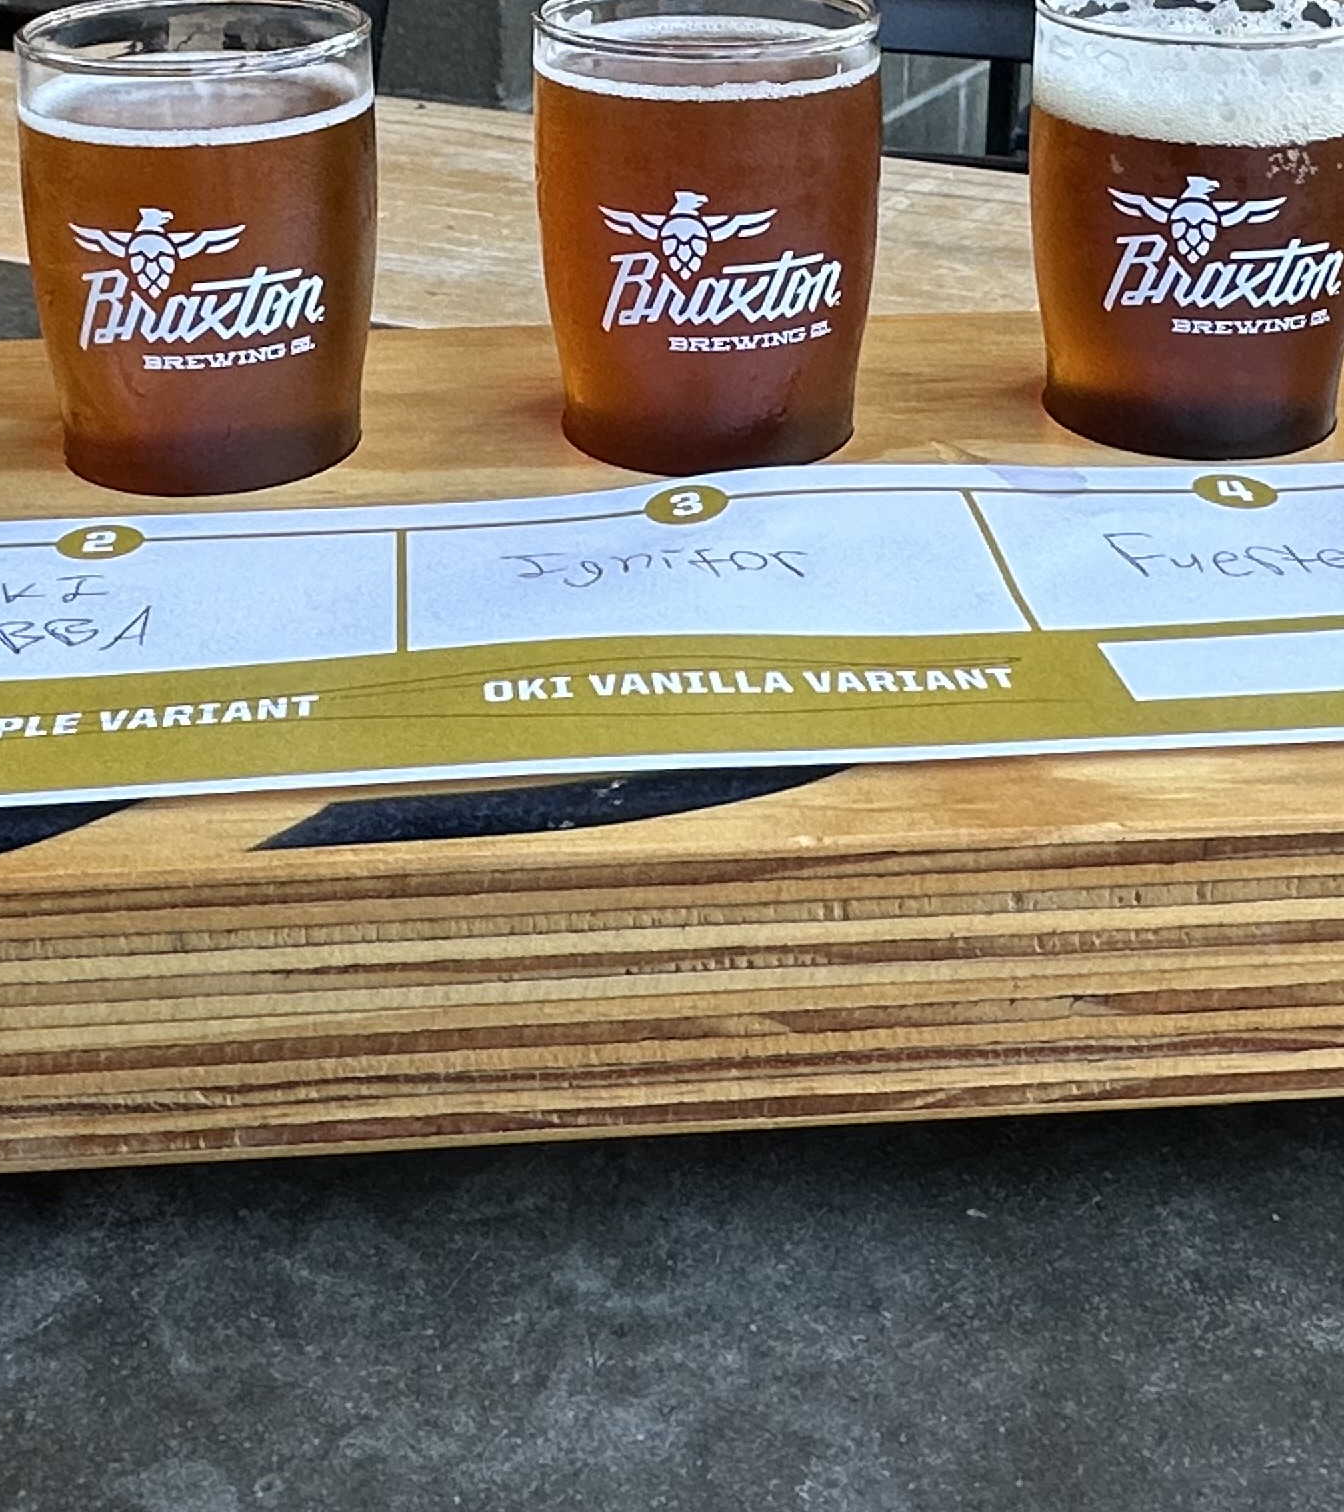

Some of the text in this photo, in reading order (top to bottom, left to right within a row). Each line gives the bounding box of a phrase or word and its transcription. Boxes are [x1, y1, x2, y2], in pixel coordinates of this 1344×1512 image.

[1103, 238, 1344, 311] Braxton
[602, 250, 842, 332] Braxton
[80, 266, 323, 351] Braxton
[1171, 314, 1307, 334] BREWING
[668, 326, 806, 351] BREWING
[143, 342, 286, 370] BREWING
[670, 492, 703, 517] 3
[1217, 478, 1254, 503] 4
[82, 530, 117, 552] 2
[483, 665, 1013, 703] OKI VANILLA VARIANT
[99, 695, 320, 733] VARIANT
